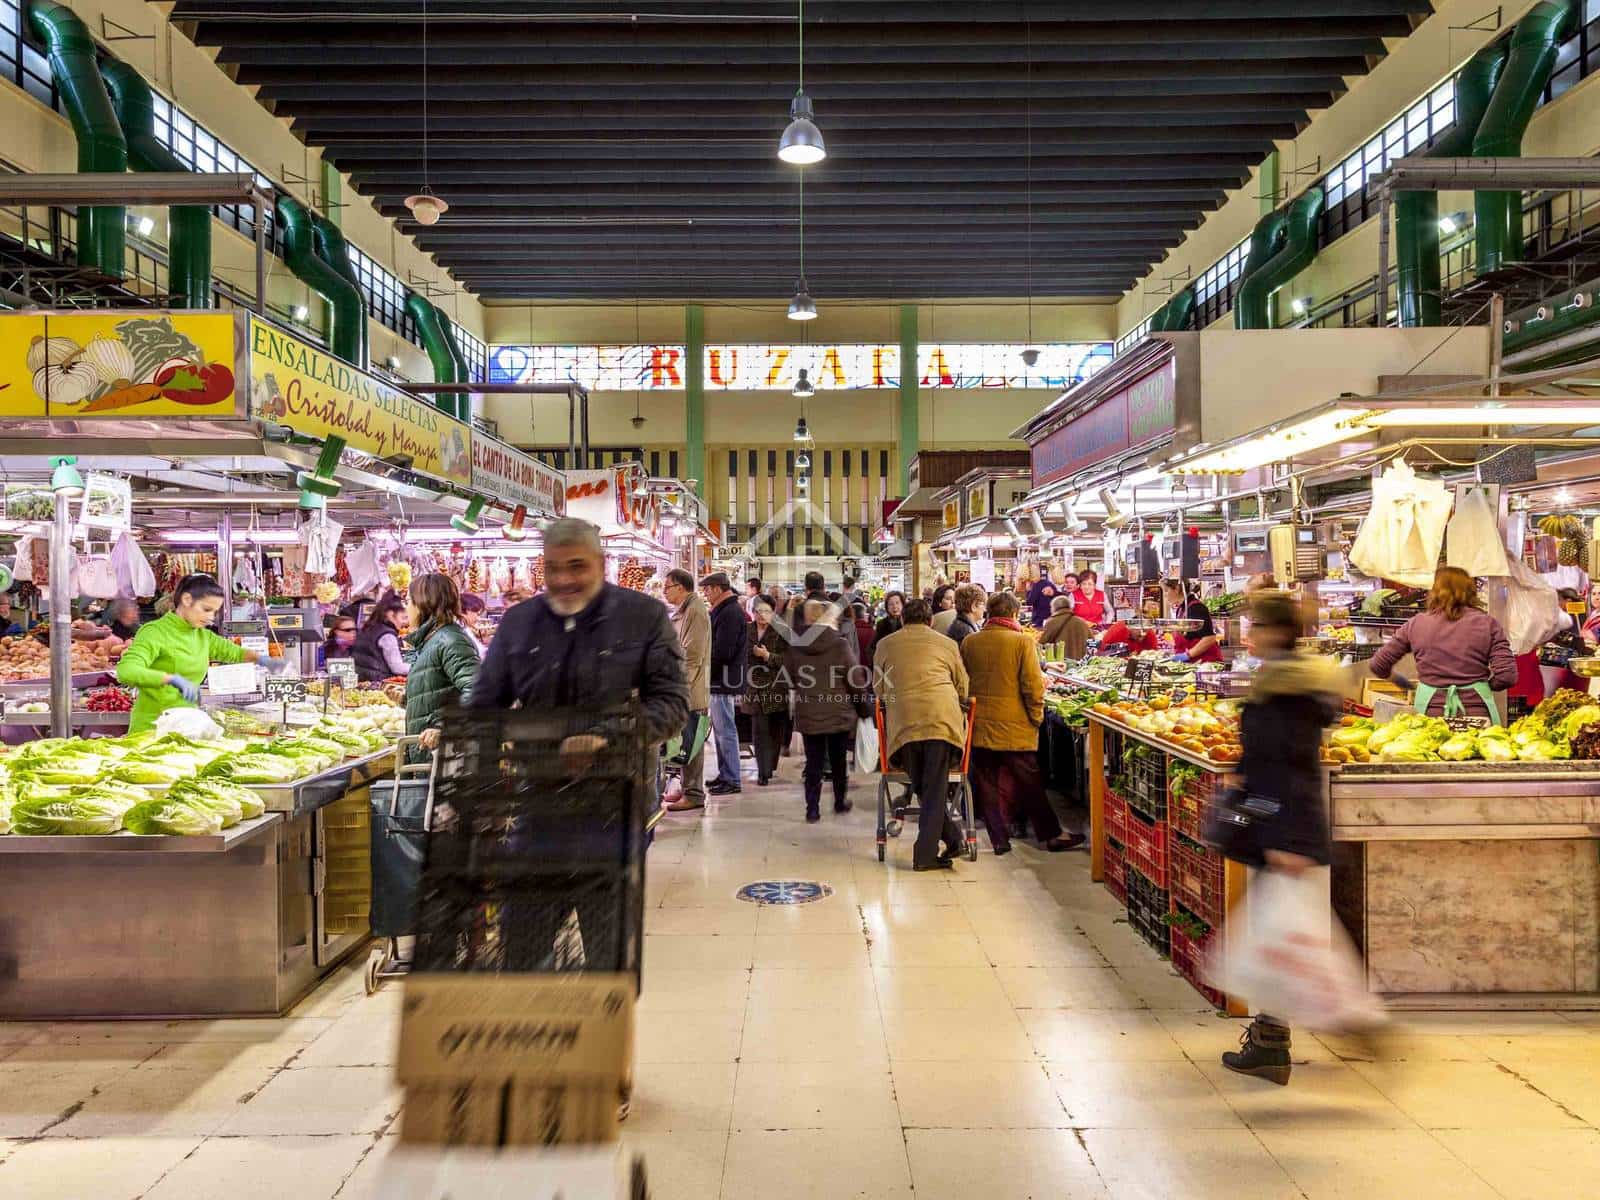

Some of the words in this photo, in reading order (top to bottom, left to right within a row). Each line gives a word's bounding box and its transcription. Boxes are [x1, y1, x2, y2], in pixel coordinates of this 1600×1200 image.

[252, 323, 371, 401] ENSALADAS
[375, 387, 438, 433] SELECTAS
[650, 348, 954, 386] RUZAFA
[286, 378, 374, 437] Cristobal
[374, 430, 387, 451] y
[392, 423, 438, 468] Maruja
[473, 439, 481, 468] EL
[504, 453, 512, 481] DE
[513, 457, 520, 483] LA
